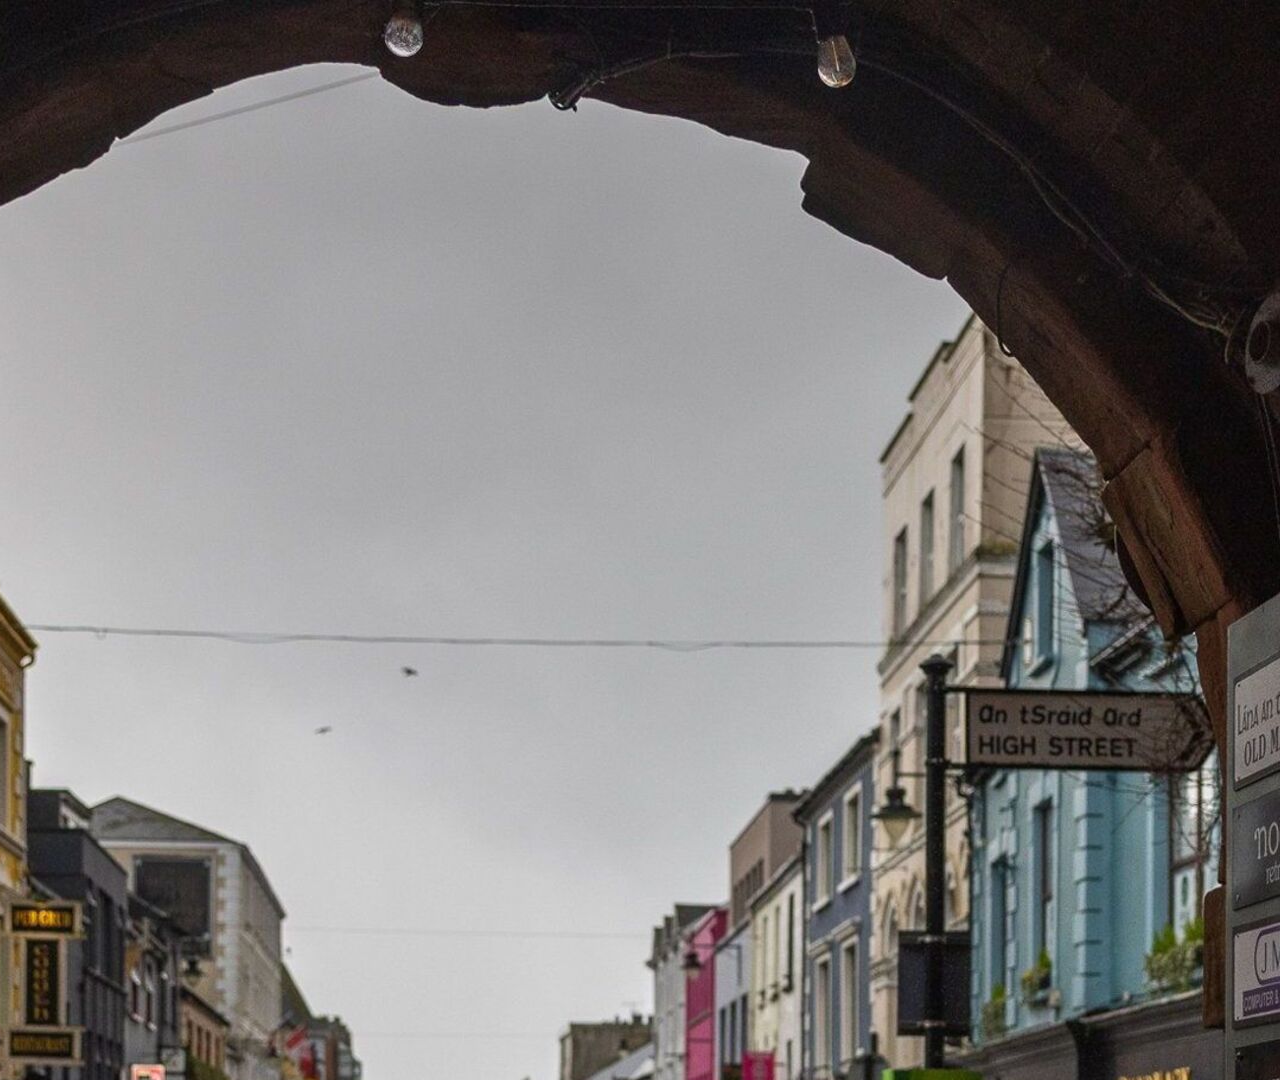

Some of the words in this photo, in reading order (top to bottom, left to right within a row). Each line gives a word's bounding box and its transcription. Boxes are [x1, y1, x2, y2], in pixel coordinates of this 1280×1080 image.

[978, 735, 1036, 756] HIGH
[1049, 736, 1137, 759] STREET
[1243, 732, 1267, 768] OLD
[1243, 989, 1274, 1012] COMPUTER
